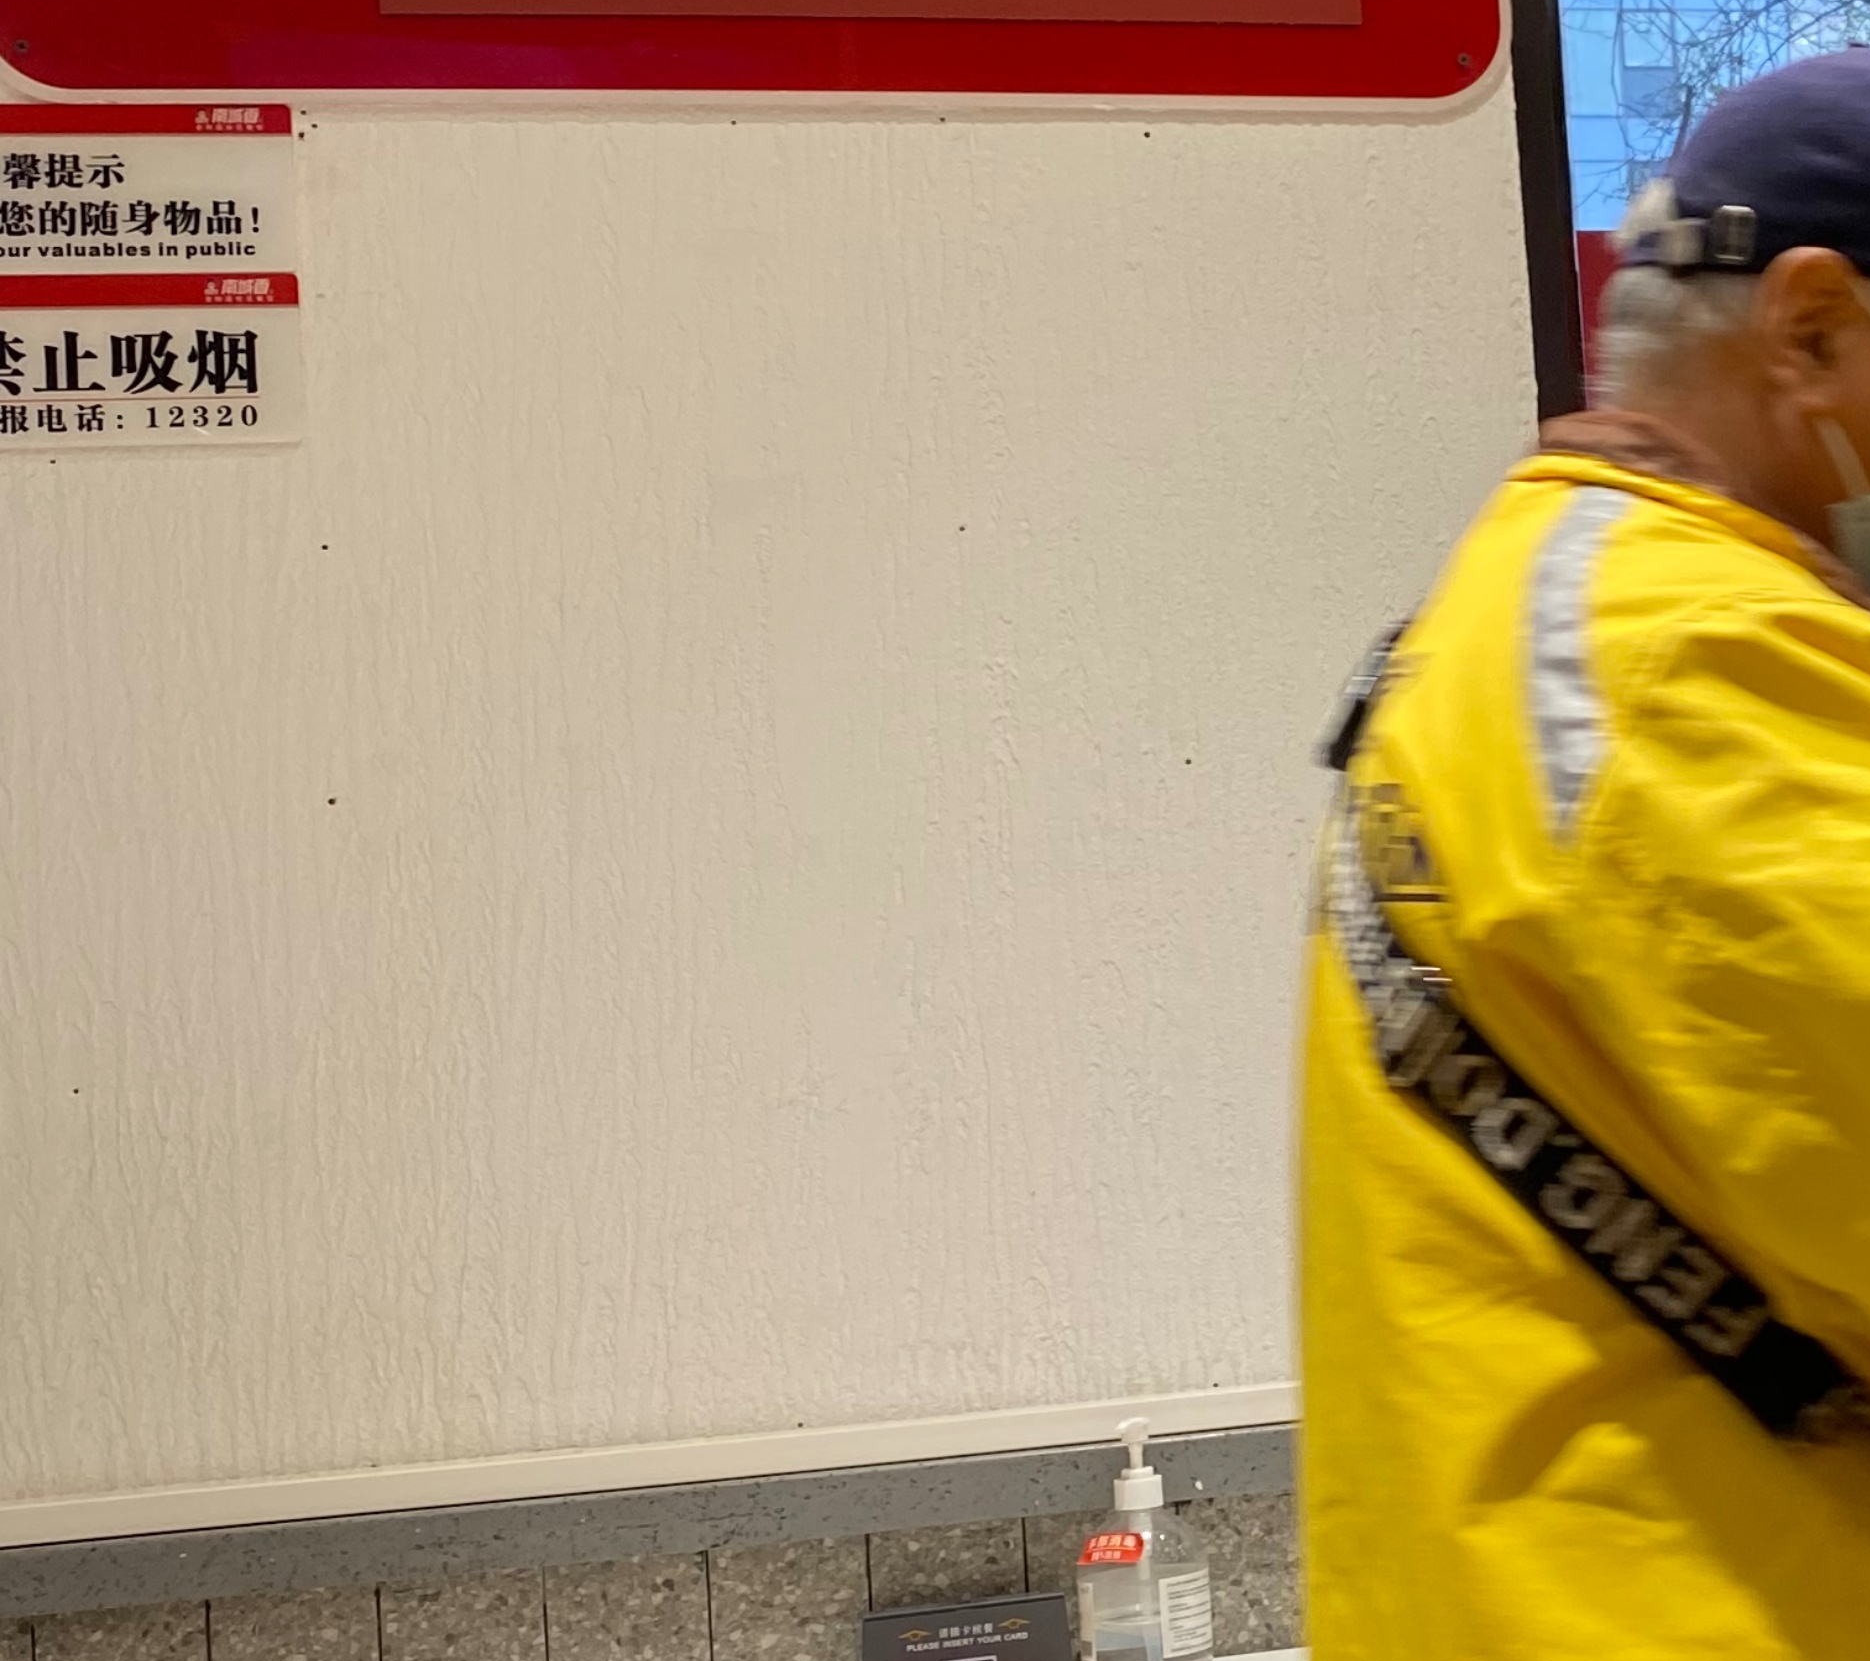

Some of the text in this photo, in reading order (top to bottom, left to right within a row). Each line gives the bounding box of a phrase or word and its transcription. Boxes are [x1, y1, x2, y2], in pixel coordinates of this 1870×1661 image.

[2, 153, 125, 189] 馨提示
[37, 241, 151, 258] valuables
[158, 242, 179, 256] in
[185, 241, 256, 259] public
[906, 1631, 1029, 1652] PLEASE INSERT YOUR CARD
